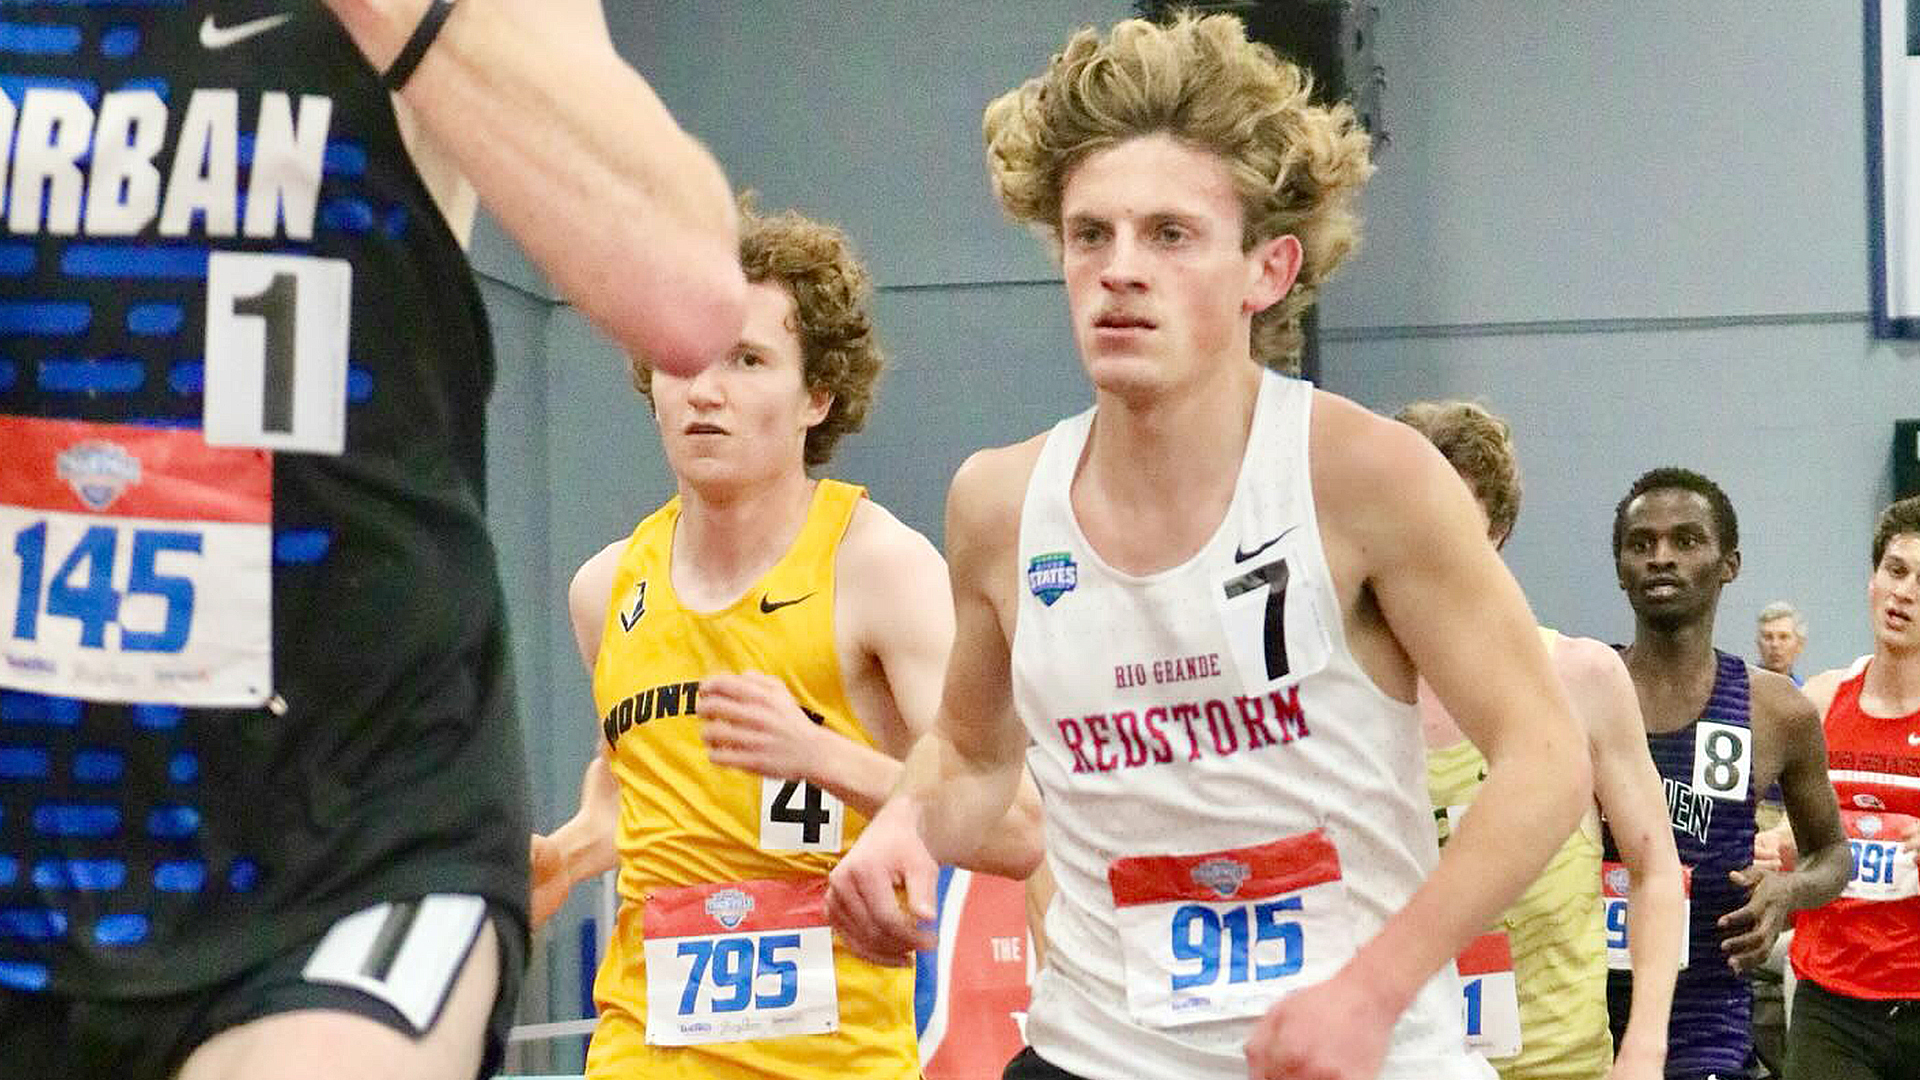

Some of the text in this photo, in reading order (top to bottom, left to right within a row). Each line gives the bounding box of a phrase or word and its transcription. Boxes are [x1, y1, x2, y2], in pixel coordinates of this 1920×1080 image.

[0, 87, 332, 240] RBAN
[233, 272, 297, 433] 1
[12, 520, 204, 653] 145
[1028, 566, 1077, 589] STATES
[1223, 557, 1290, 681] 7
[1115, 653, 1221, 688] RIO GRANDE
[603, 681, 700, 751] MOUNT
[1057, 684, 1311, 774] REDSTORM
[1704, 728, 1745, 792] 8
[770, 777, 830, 843] 4
[676, 933, 801, 1016] 795
[1170, 896, 1305, 991] 915
